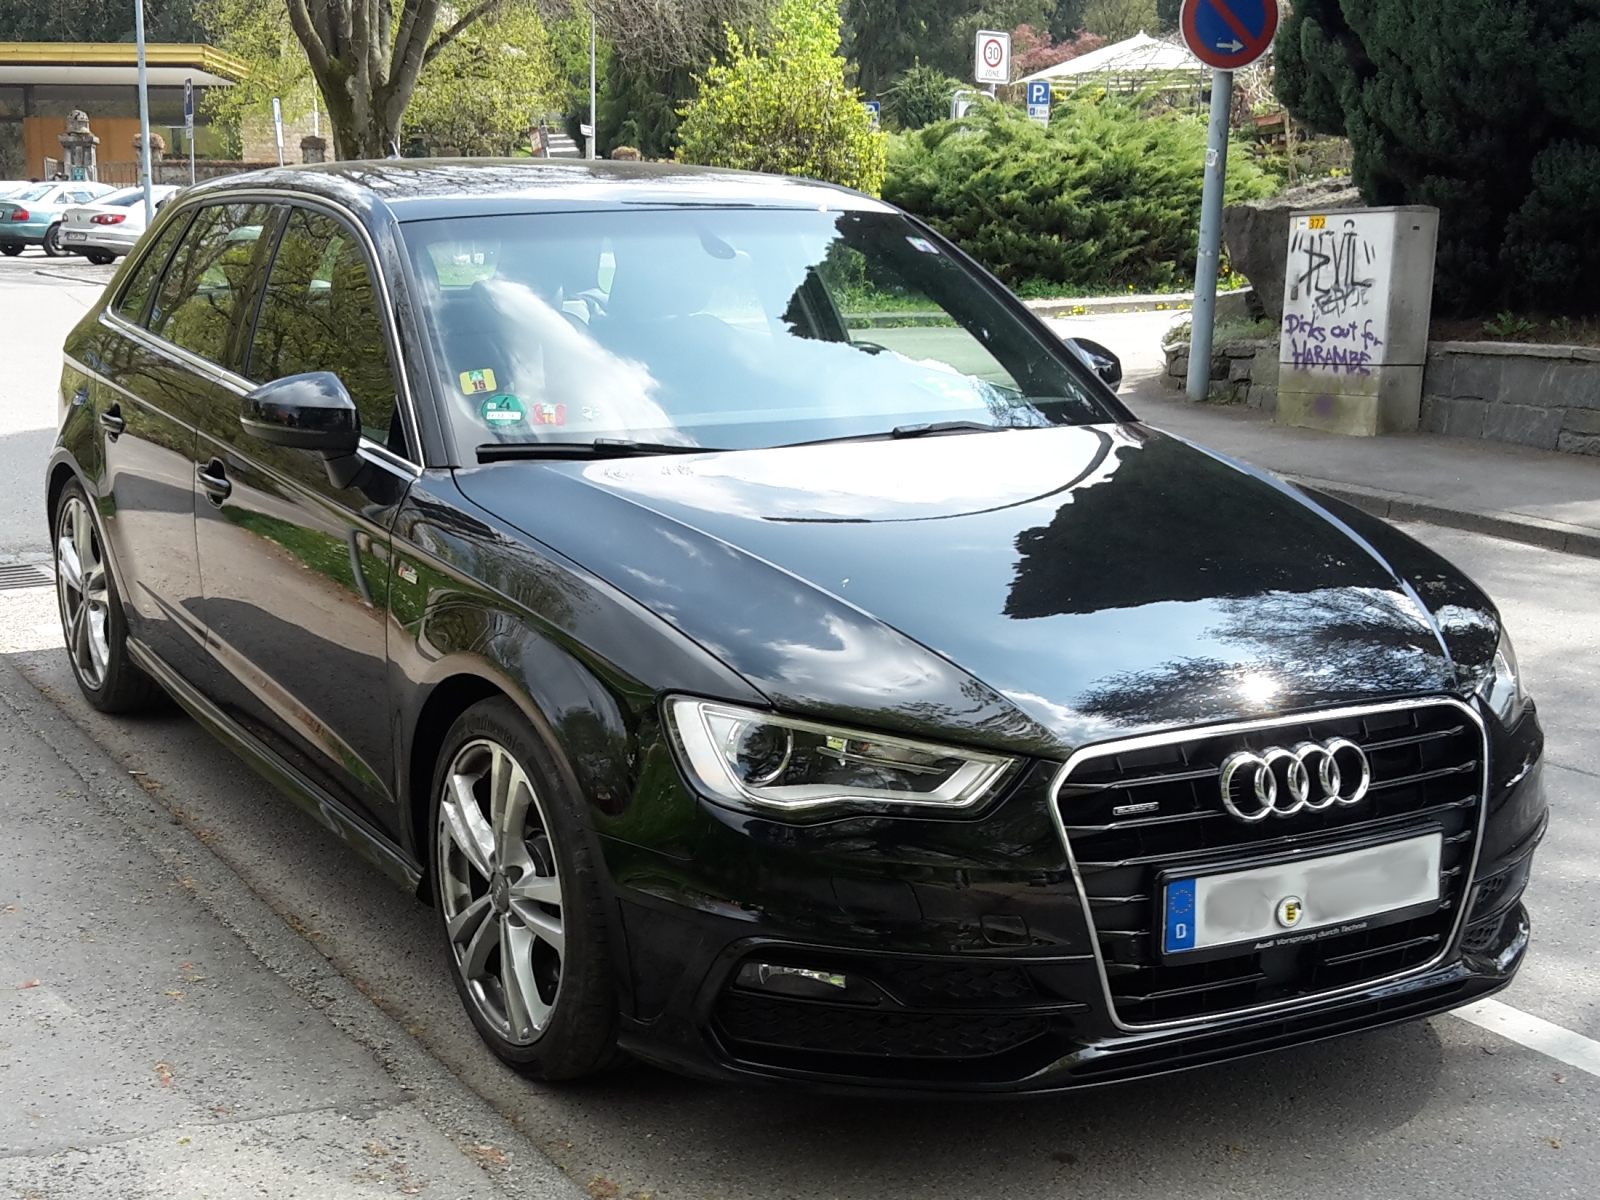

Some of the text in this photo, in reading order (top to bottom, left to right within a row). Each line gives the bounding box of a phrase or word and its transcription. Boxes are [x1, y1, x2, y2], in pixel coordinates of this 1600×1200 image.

[987, 46, 1000, 60] 30
[985, 69, 1000, 78] ZONE
[1033, 84, 1045, 103] P
[1310, 217, 1326, 230] 372
[1329, 320, 1358, 342] out
[1360, 319, 1384, 351] for
[1291, 337, 1372, 377] HARAMBE
[471, 380, 487, 391] 15
[498, 396, 512, 411] 4
[543, 412, 557, 425] 14
[1175, 923, 1187, 939] D
[1254, 940, 1275, 950] Audi
